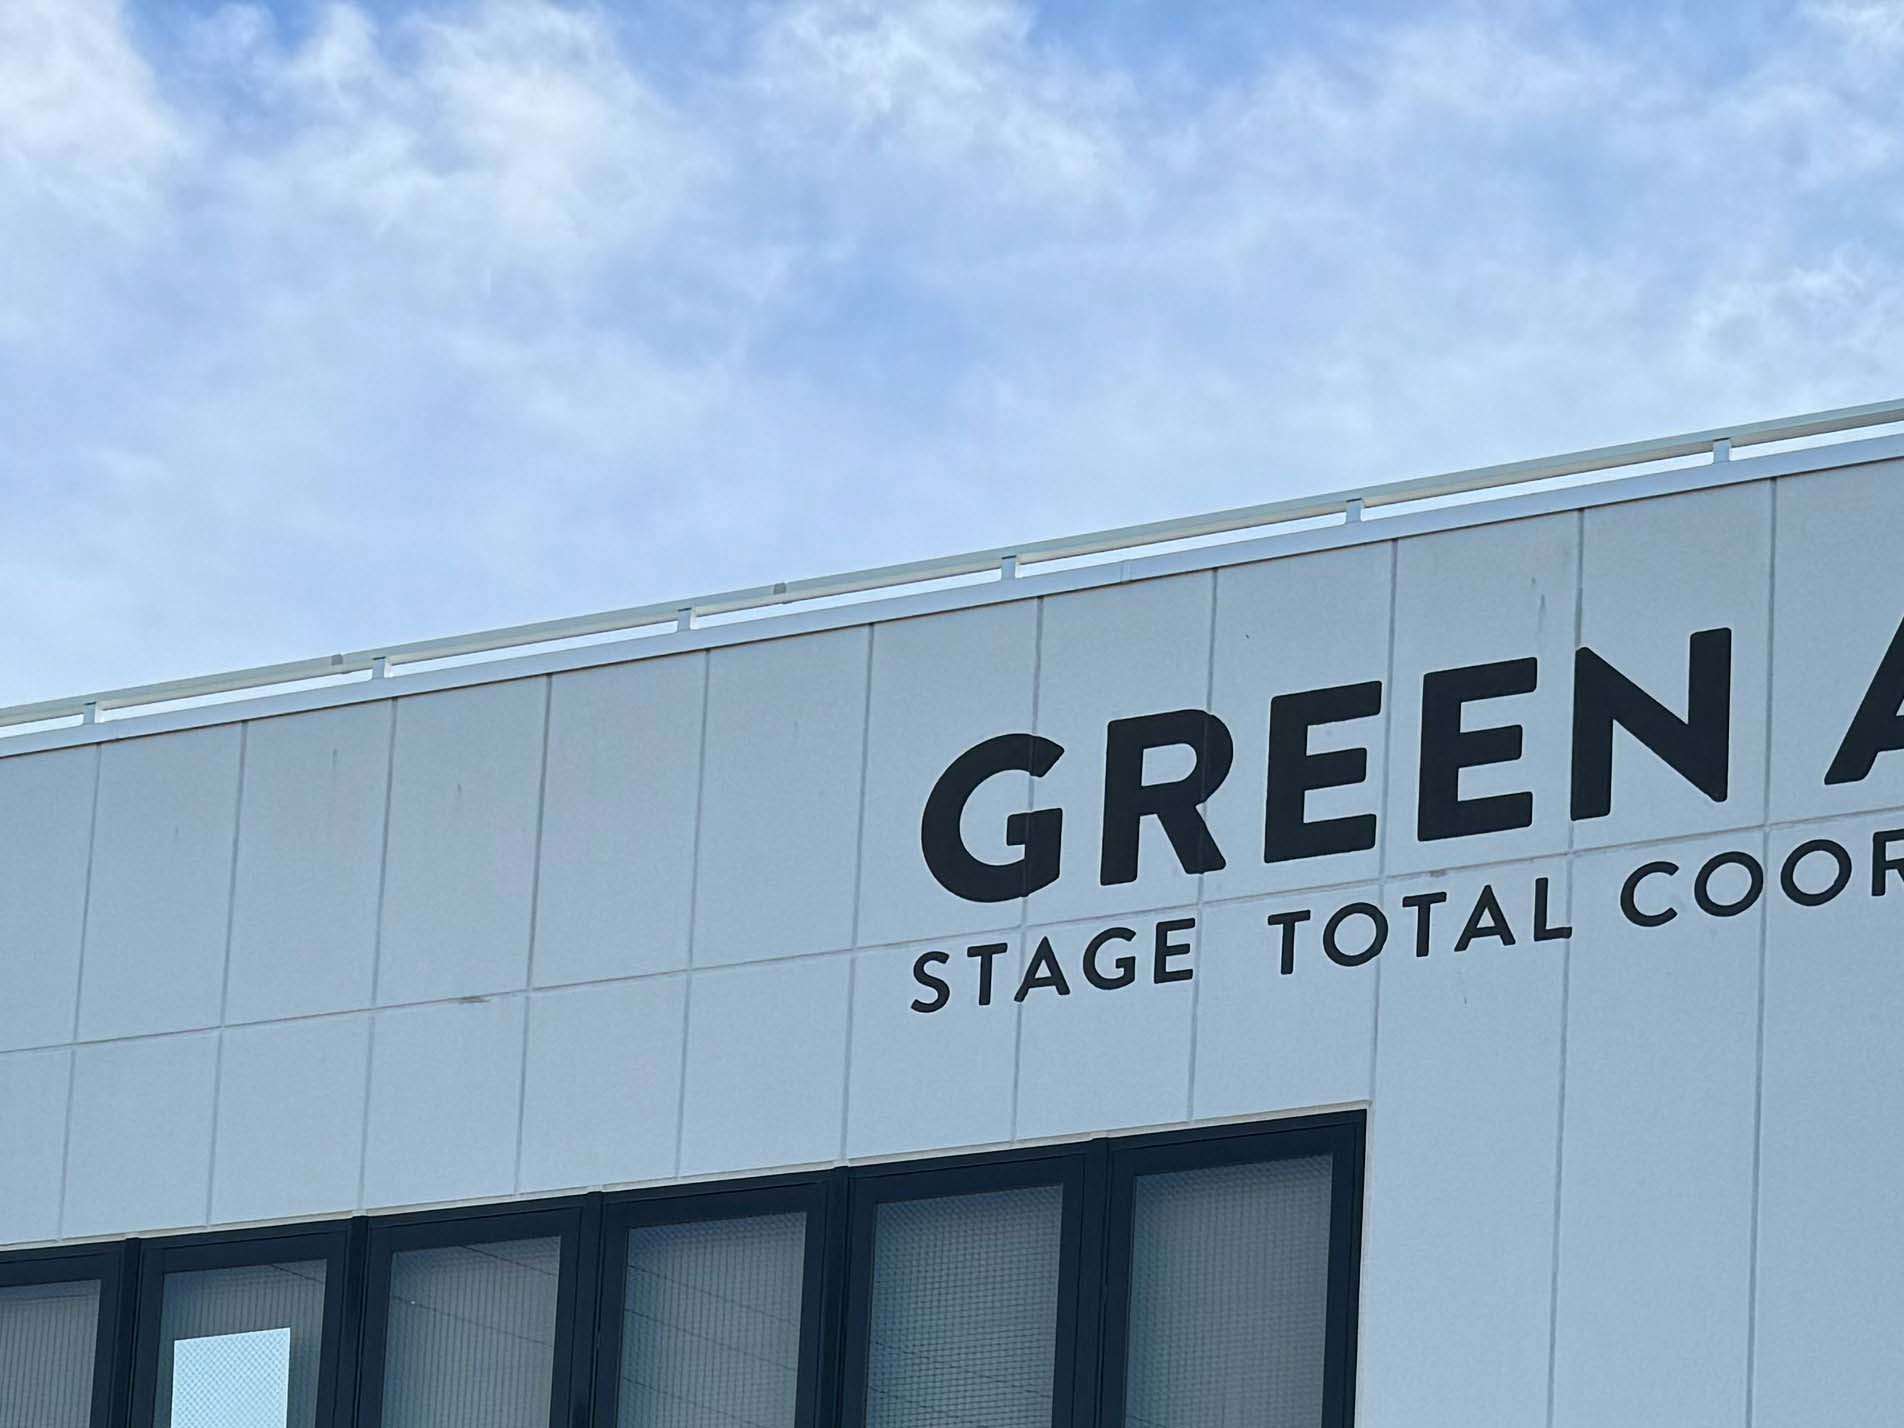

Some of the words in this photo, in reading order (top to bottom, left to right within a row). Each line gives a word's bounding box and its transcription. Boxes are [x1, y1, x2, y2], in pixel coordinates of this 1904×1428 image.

[920, 627, 1732, 904] GREEN
[910, 917, 1196, 1014] STAGE
[1267, 877, 1573, 976] TOTAL
